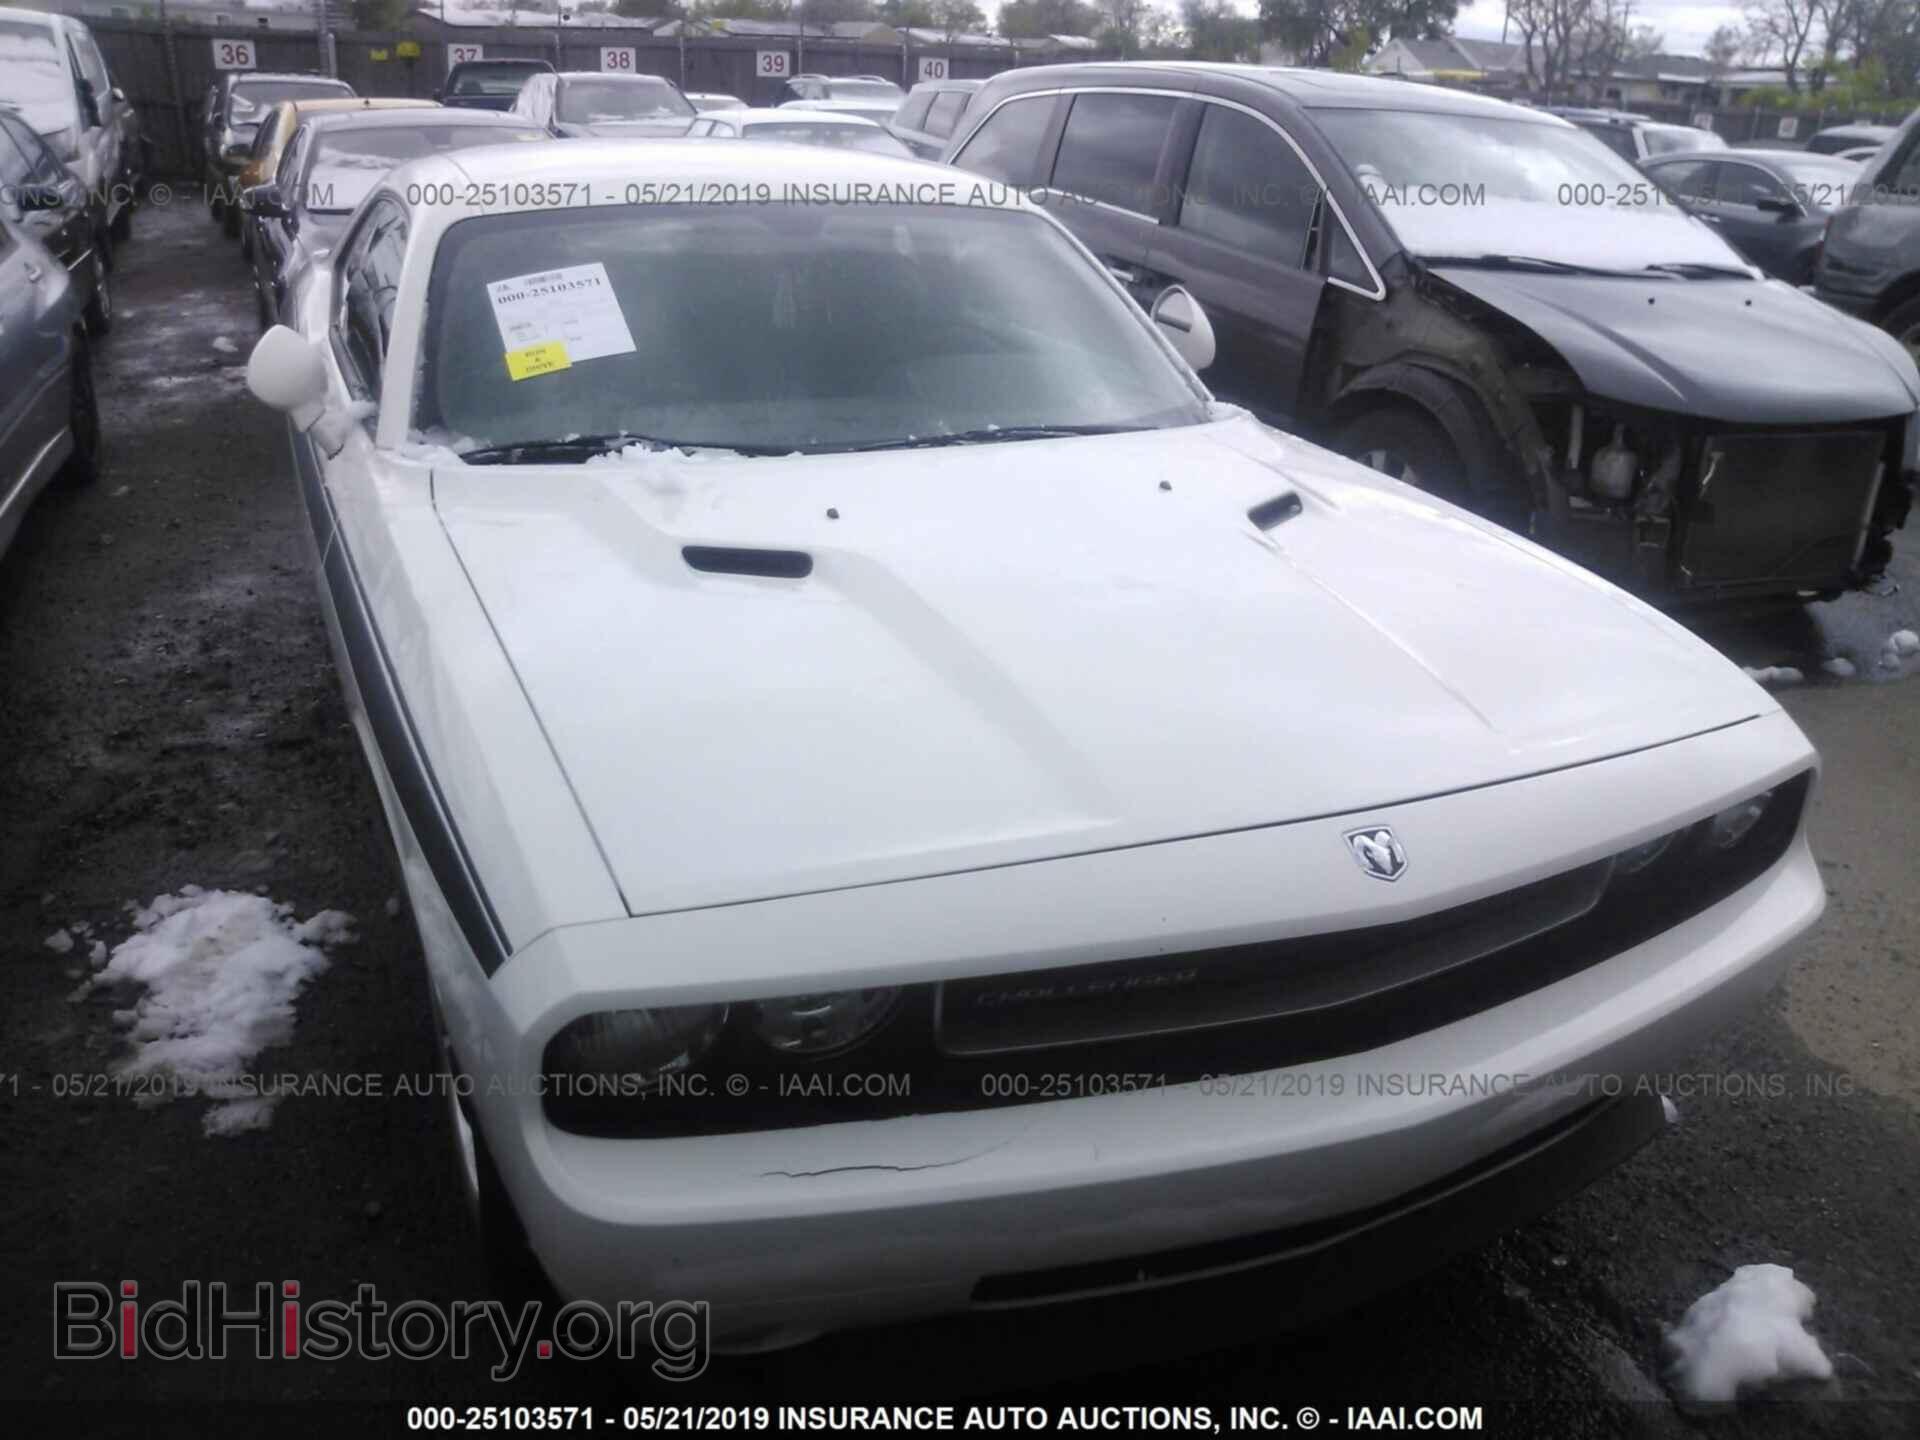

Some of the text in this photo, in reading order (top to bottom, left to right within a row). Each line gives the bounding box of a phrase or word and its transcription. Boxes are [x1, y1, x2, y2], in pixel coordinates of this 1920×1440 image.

[221, 43, 249, 65] 36
[454, 48, 478, 62] 37
[606, 51, 631, 69] 38
[762, 54, 785, 73] 39
[924, 61, 944, 79] 40
[498, 276, 602, 305] 000-25103571
